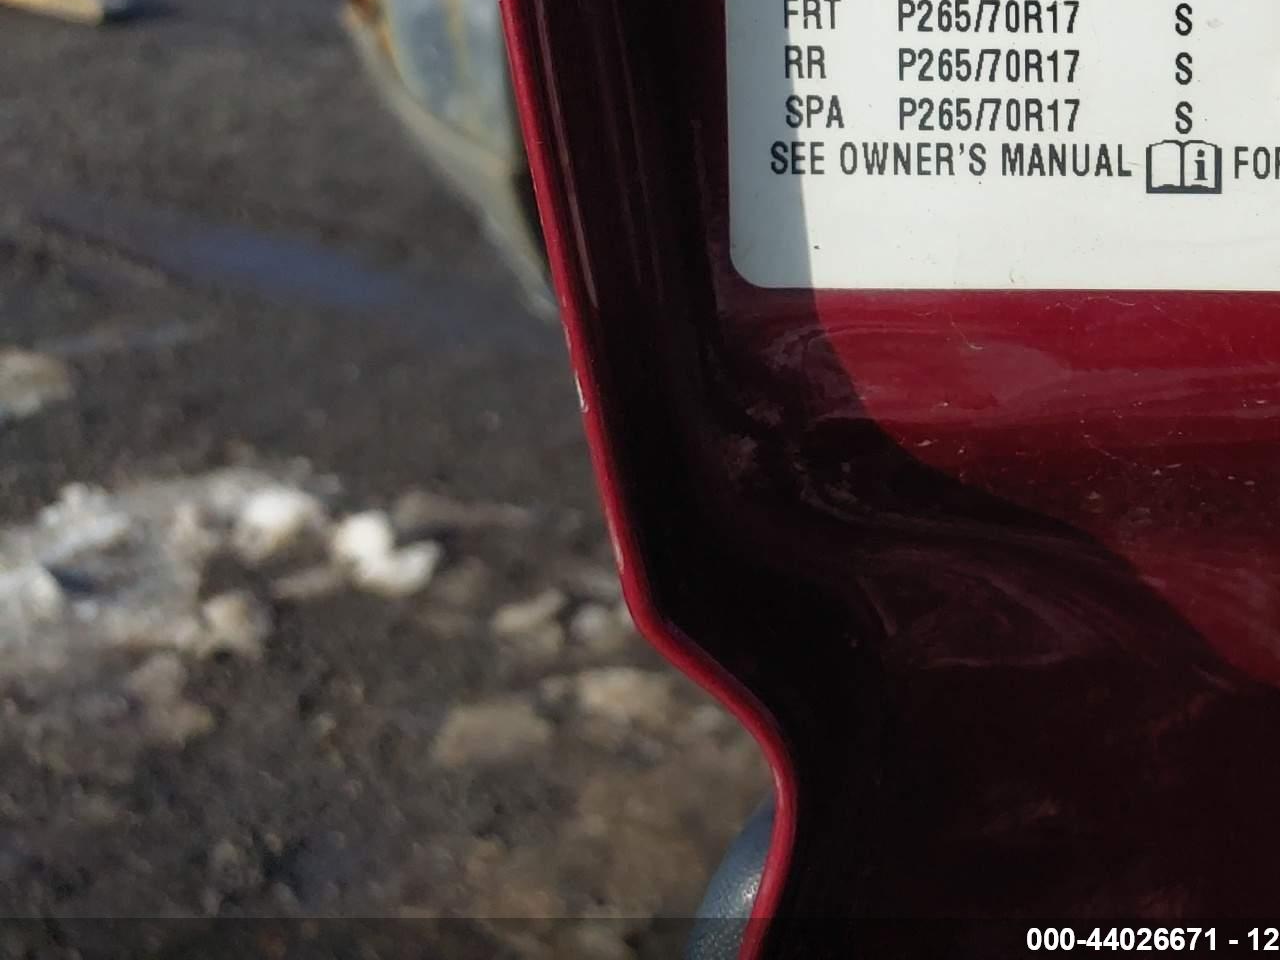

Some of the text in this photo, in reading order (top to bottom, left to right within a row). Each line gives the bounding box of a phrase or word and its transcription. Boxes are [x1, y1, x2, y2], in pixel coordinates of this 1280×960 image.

[898, 0, 1079, 33] P265/70R17
[1175, 3, 1192, 36] S
[785, 45, 826, 79] RR
[899, 48, 1079, 82] P265/70R17
[1176, 52, 1192, 85] S
[786, 95, 844, 128] SPA
[899, 97, 1080, 132] P265/70R17
[1176, 101, 1192, 134] S
[771, 141, 824, 174] SEE
[840, 142, 986, 176] OWNER'S
[1002, 143, 1132, 176] MANUAL
